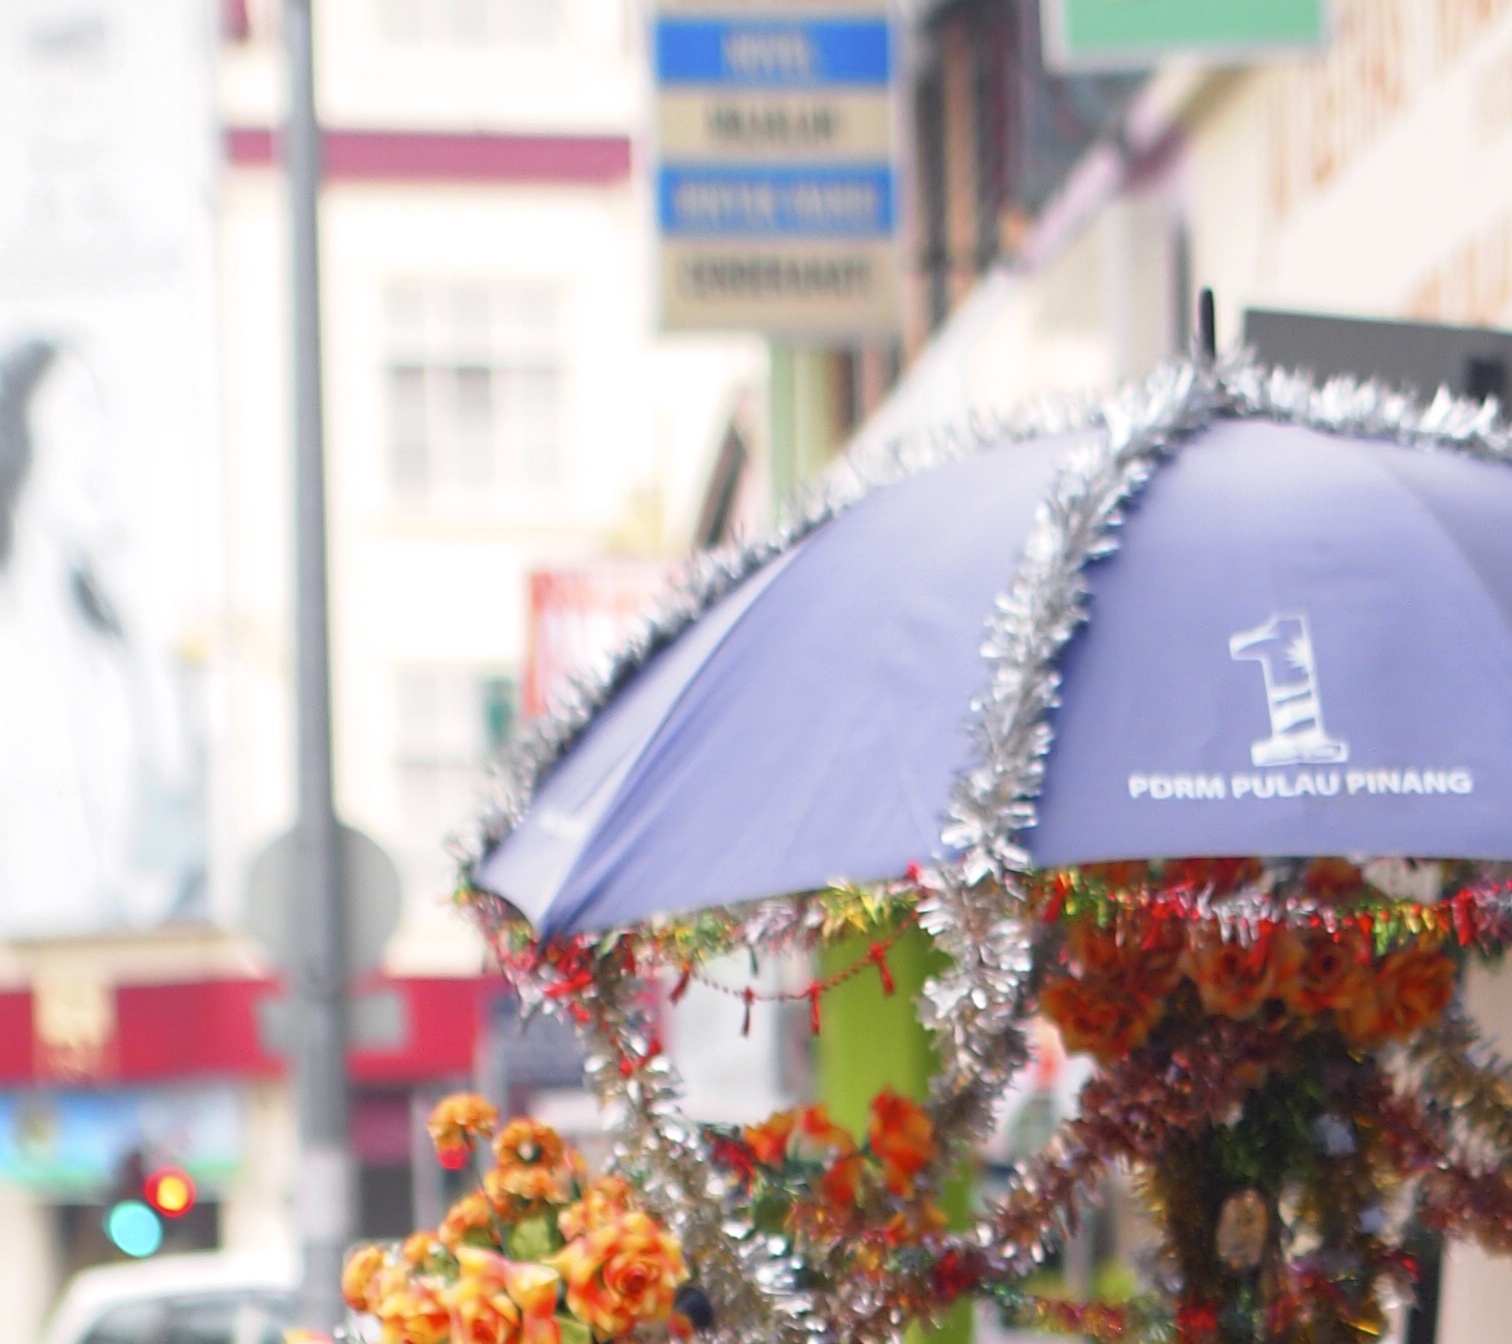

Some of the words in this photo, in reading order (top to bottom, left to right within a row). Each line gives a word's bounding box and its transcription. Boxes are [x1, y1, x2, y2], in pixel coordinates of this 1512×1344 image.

[1128, 774, 1225, 799] PDRM
[1231, 771, 1340, 798] PULAU
[1346, 769, 1473, 795] PINANG
